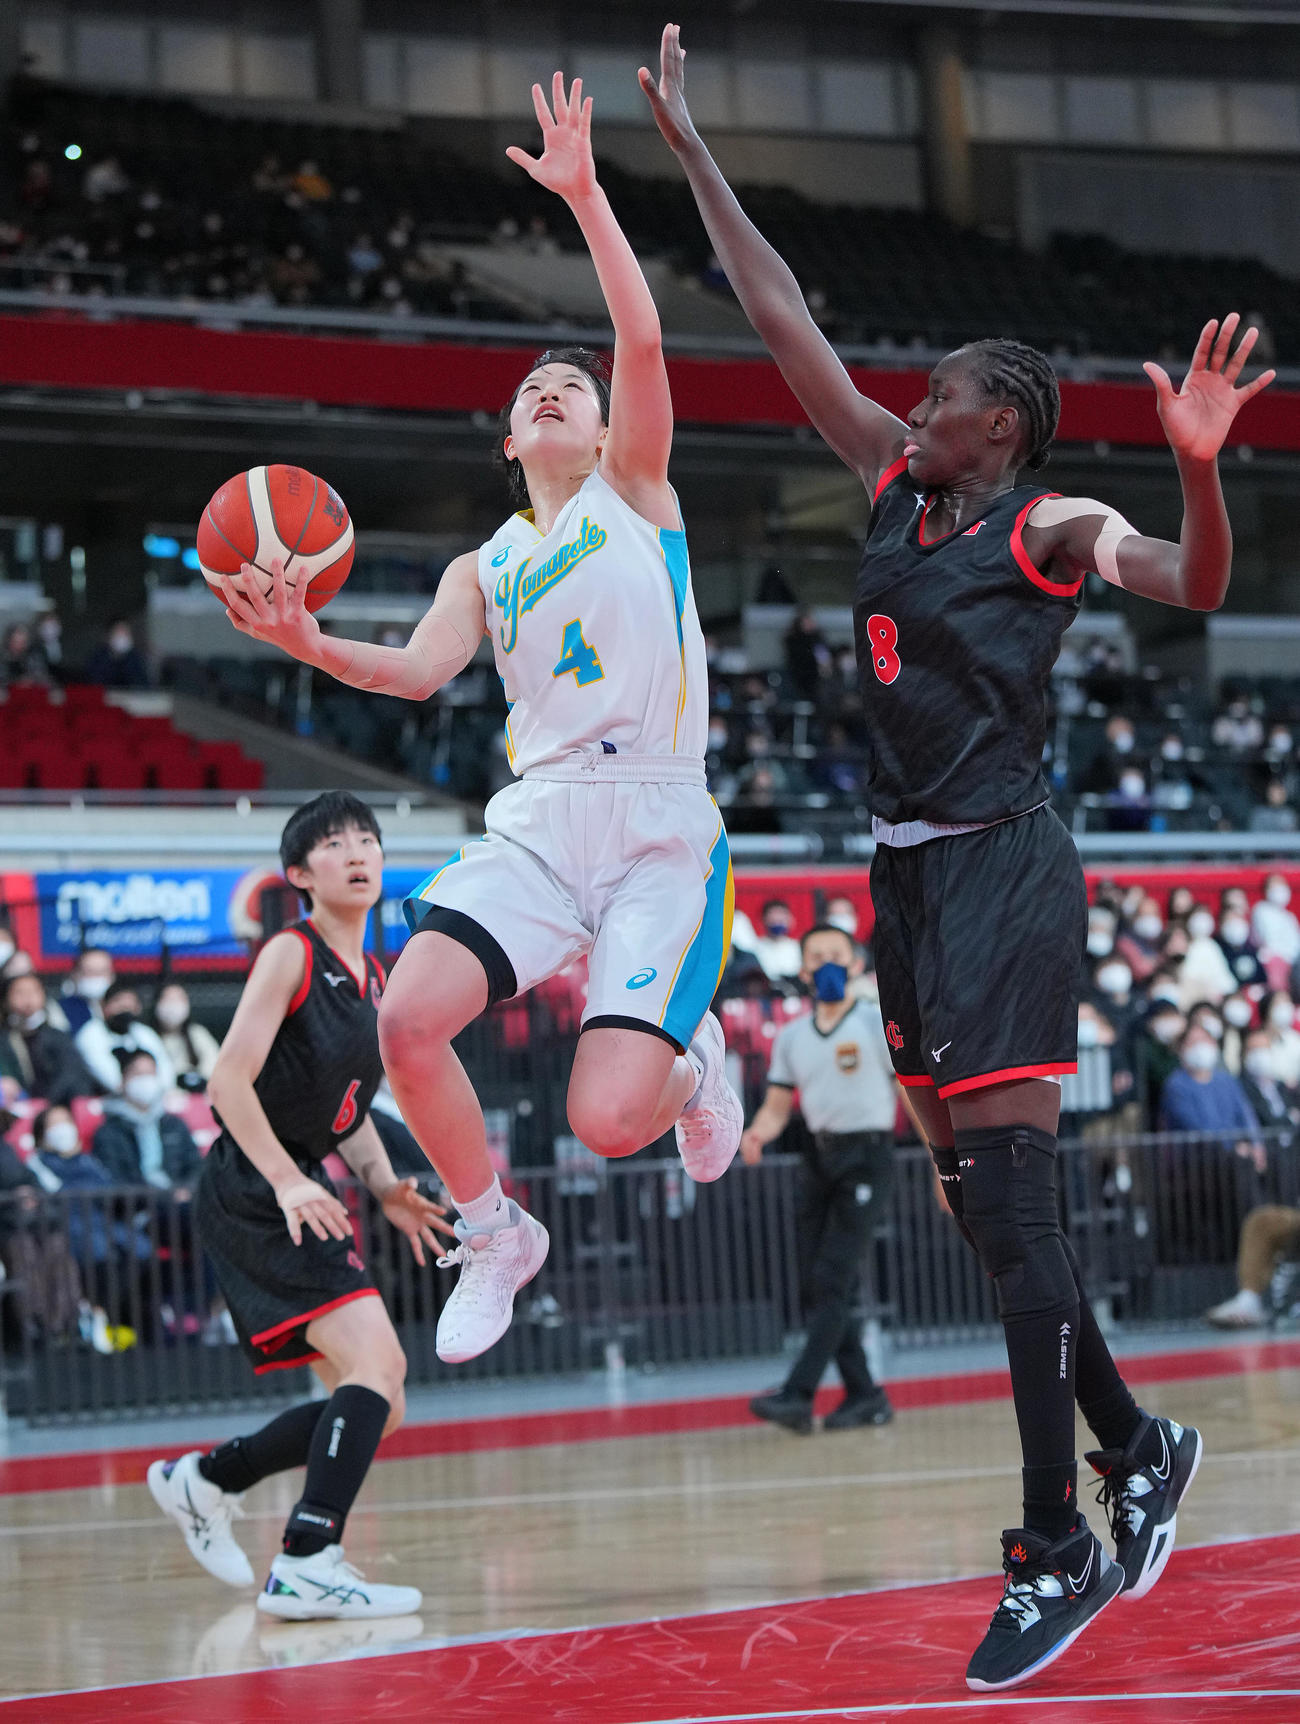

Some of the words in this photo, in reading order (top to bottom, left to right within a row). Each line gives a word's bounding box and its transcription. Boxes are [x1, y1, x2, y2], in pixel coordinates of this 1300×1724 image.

[285, 467, 301, 496] mol
[494, 515, 607, 655] Yamanote
[552, 617, 606, 688] 4
[867, 614, 901, 685] 8
[331, 1079, 362, 1134] 6
